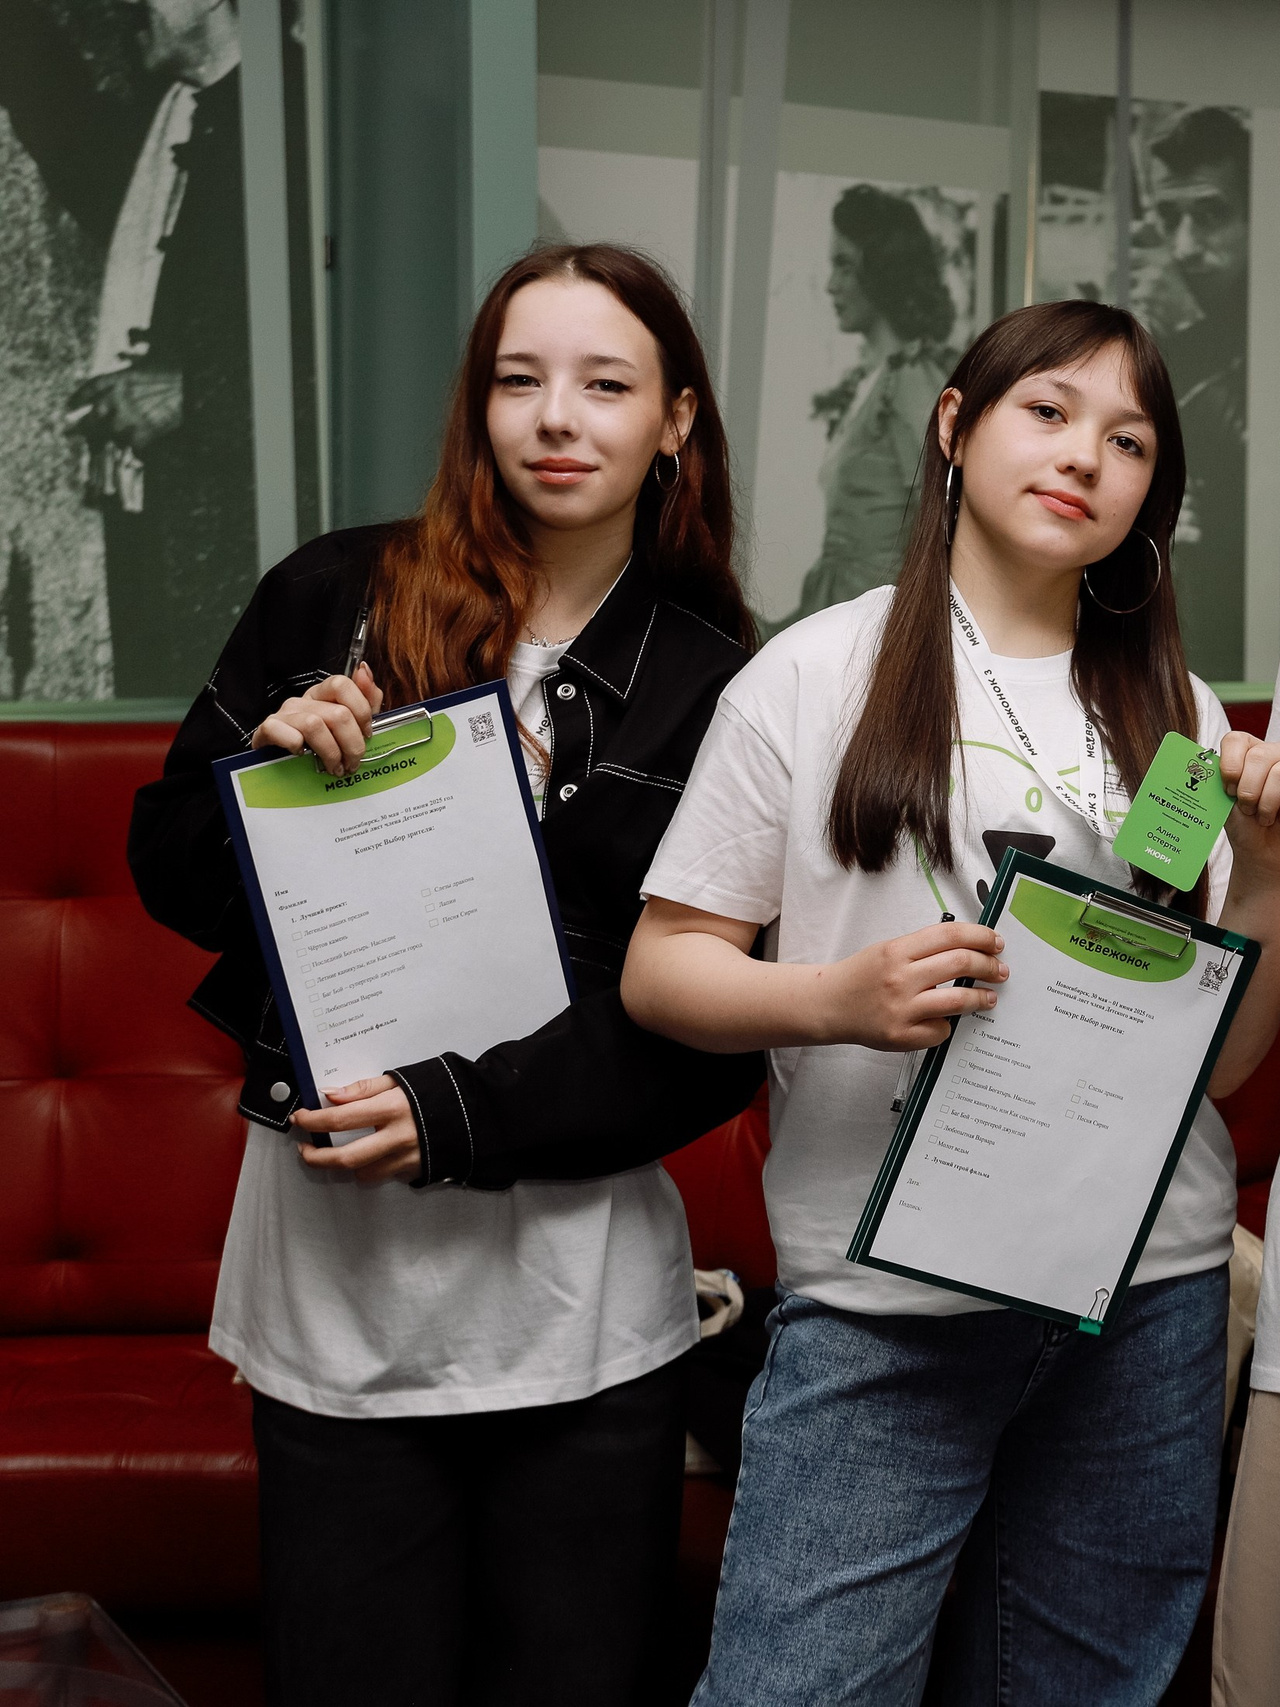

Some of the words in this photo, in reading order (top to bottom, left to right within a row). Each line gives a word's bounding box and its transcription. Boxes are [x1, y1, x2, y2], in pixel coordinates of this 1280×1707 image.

[950, 592, 980, 646] медвежо
[988, 678, 1038, 756] медвежонок
[325, 757, 417, 792] медвежонок
[1148, 792, 1204, 826] медвежонок
[1147, 832, 1182, 854] Остертак
[1156, 826, 1180, 842] Алина
[1145, 846, 1172, 865] ЖЮРИ
[1069, 934, 1151, 971] медвежонок
